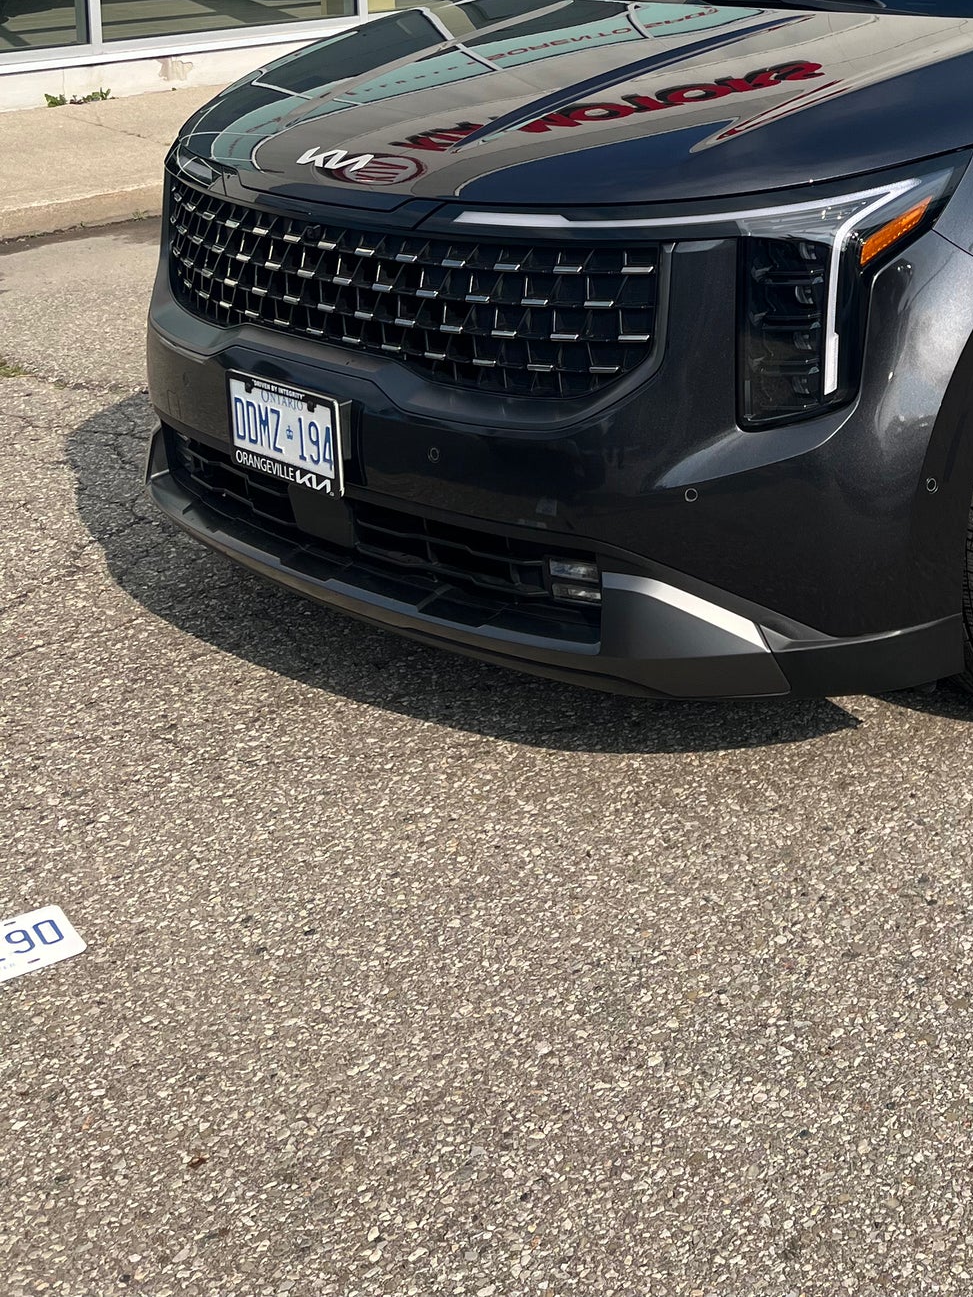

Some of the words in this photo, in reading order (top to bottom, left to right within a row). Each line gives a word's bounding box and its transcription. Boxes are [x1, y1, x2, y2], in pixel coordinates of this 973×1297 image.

[296, 146, 374, 172] KIA
[261, 389, 303, 411] ONTARIO
[233, 396, 283, 454] DDMZ
[298, 417, 334, 472] 194
[235, 450, 295, 482] ORANGEVILLE
[295, 469, 331, 494] KIA
